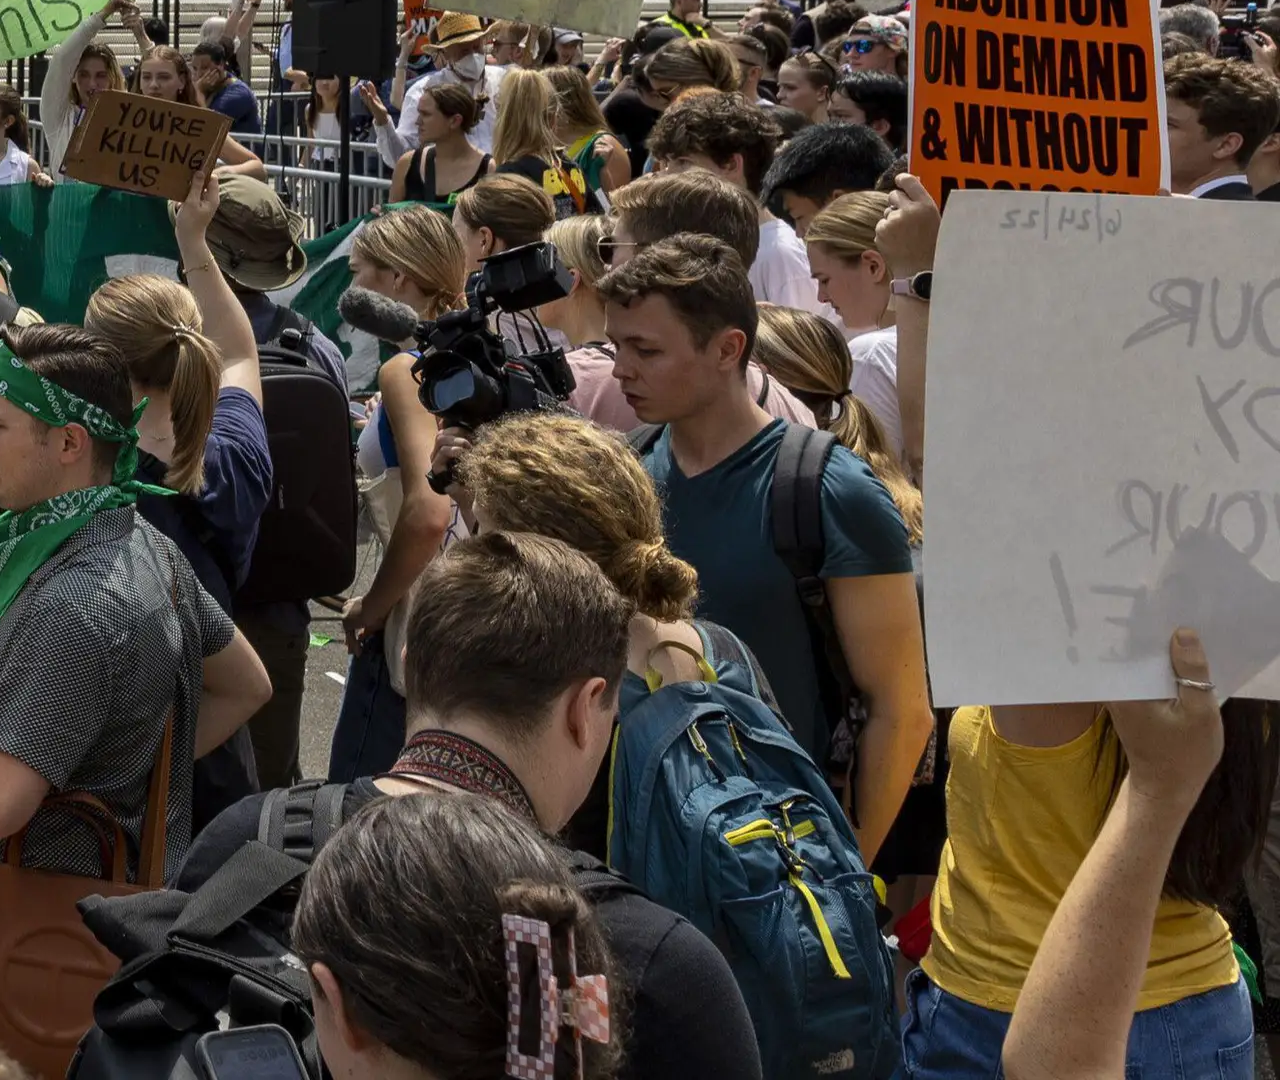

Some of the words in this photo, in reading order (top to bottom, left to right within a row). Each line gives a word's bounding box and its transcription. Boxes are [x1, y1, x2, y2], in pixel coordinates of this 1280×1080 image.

[924, 21, 966, 87] ON
[976, 29, 1148, 103] DEMAND
[99, 127, 205, 170] KILLING
[119, 101, 205, 137] YOU'RE
[920, 107, 947, 161] &
[954, 102, 1148, 178] WITHOUT
